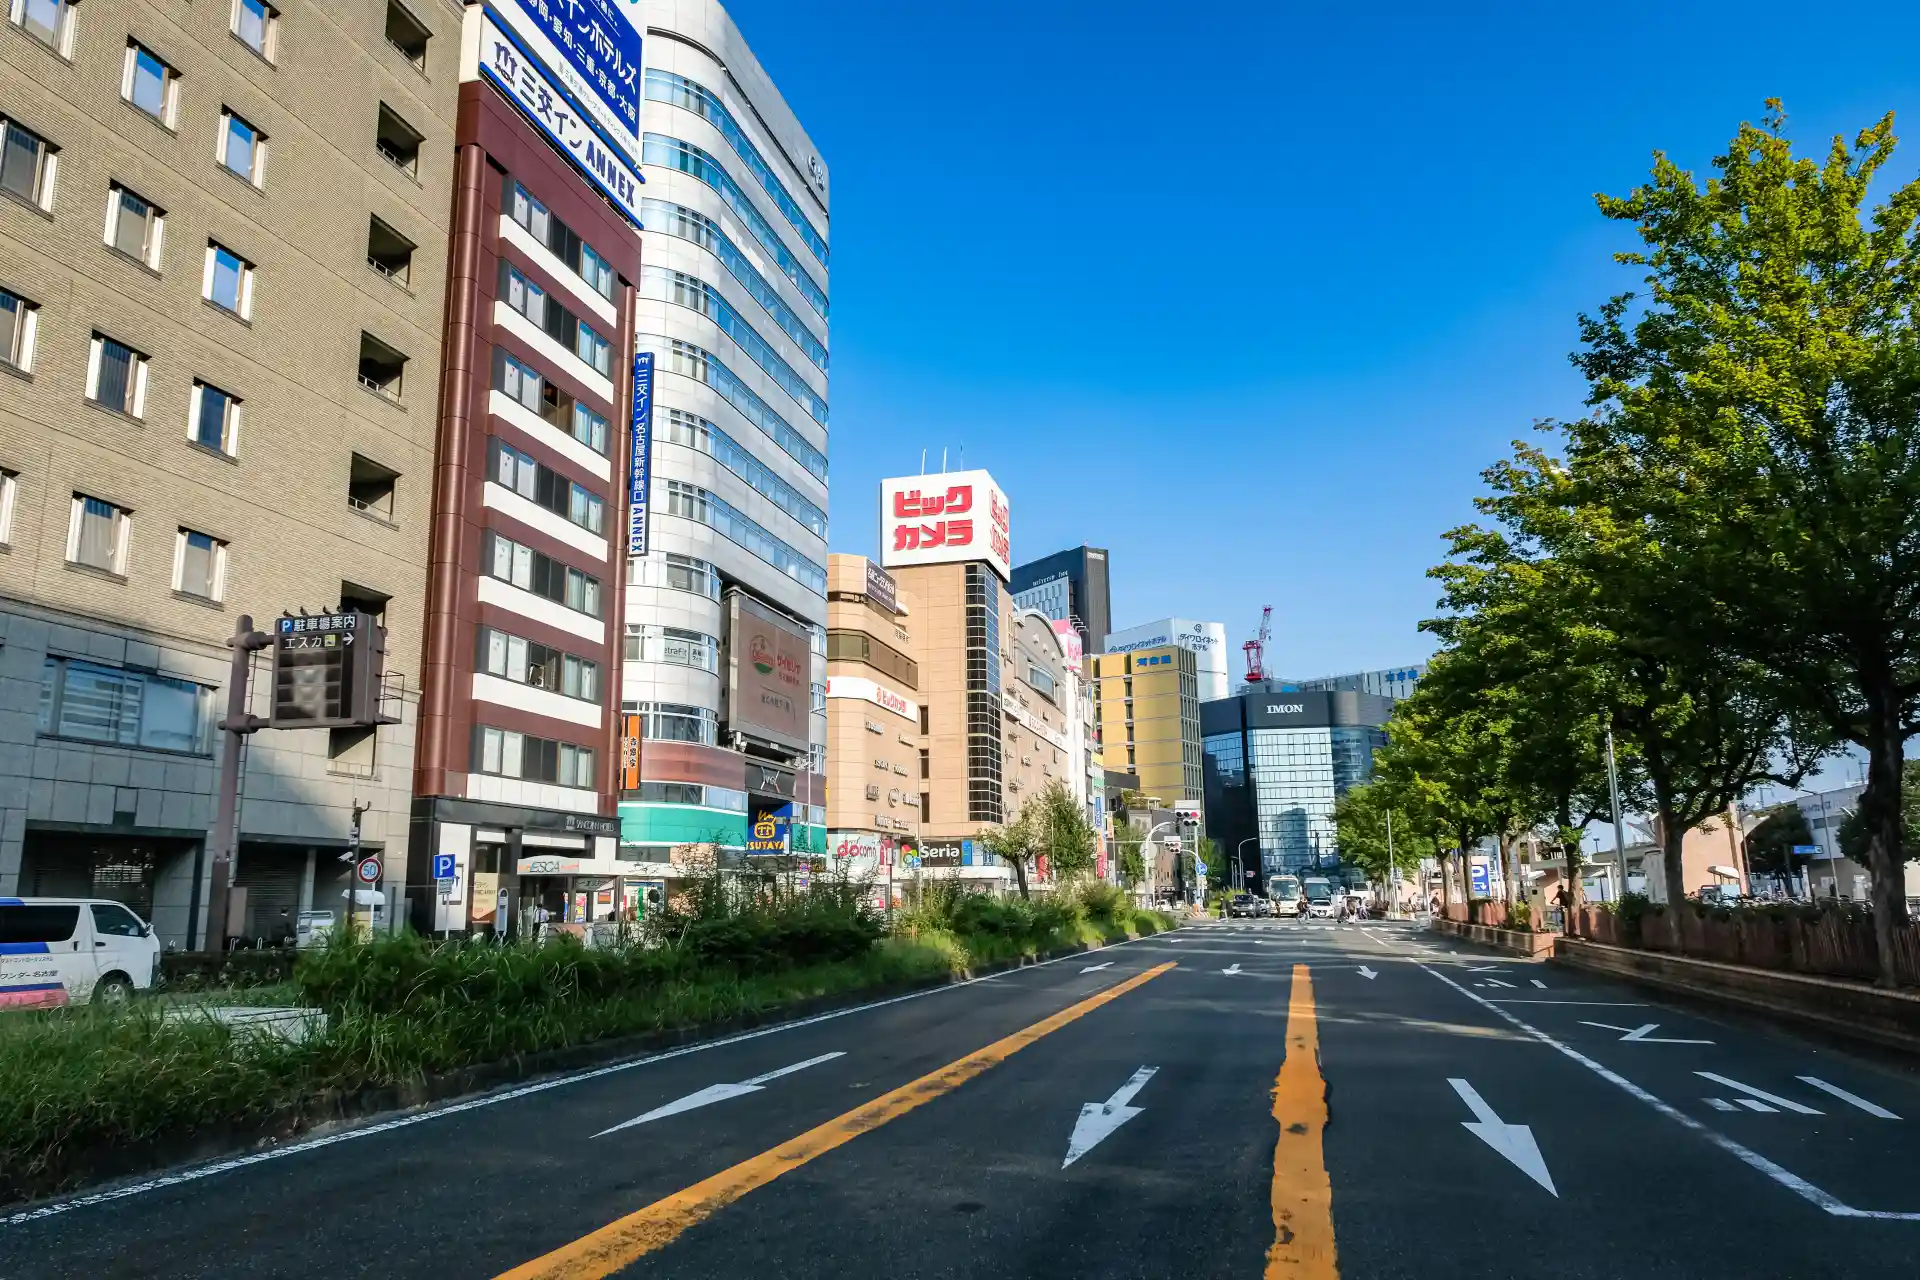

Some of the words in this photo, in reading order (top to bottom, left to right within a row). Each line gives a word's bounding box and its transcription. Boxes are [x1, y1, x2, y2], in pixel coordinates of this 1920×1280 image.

[520, 66, 582, 149] 三交イン
[586, 140, 635, 208] ANNEX
[894, 485, 973, 518] ビック
[632, 507, 644, 552] ANNEX
[894, 519, 973, 552] カメラ
[294, 616, 356, 632] 駐車場案内
[285, 637, 323, 649] エスカ
[1266, 704, 1304, 714] IMON
[837, 840, 877, 857] docomo
[921, 844, 960, 858] Seria
[363, 865, 377, 876] 50
[439, 857, 452, 875] P
[529, 861, 560, 873] ESCA
